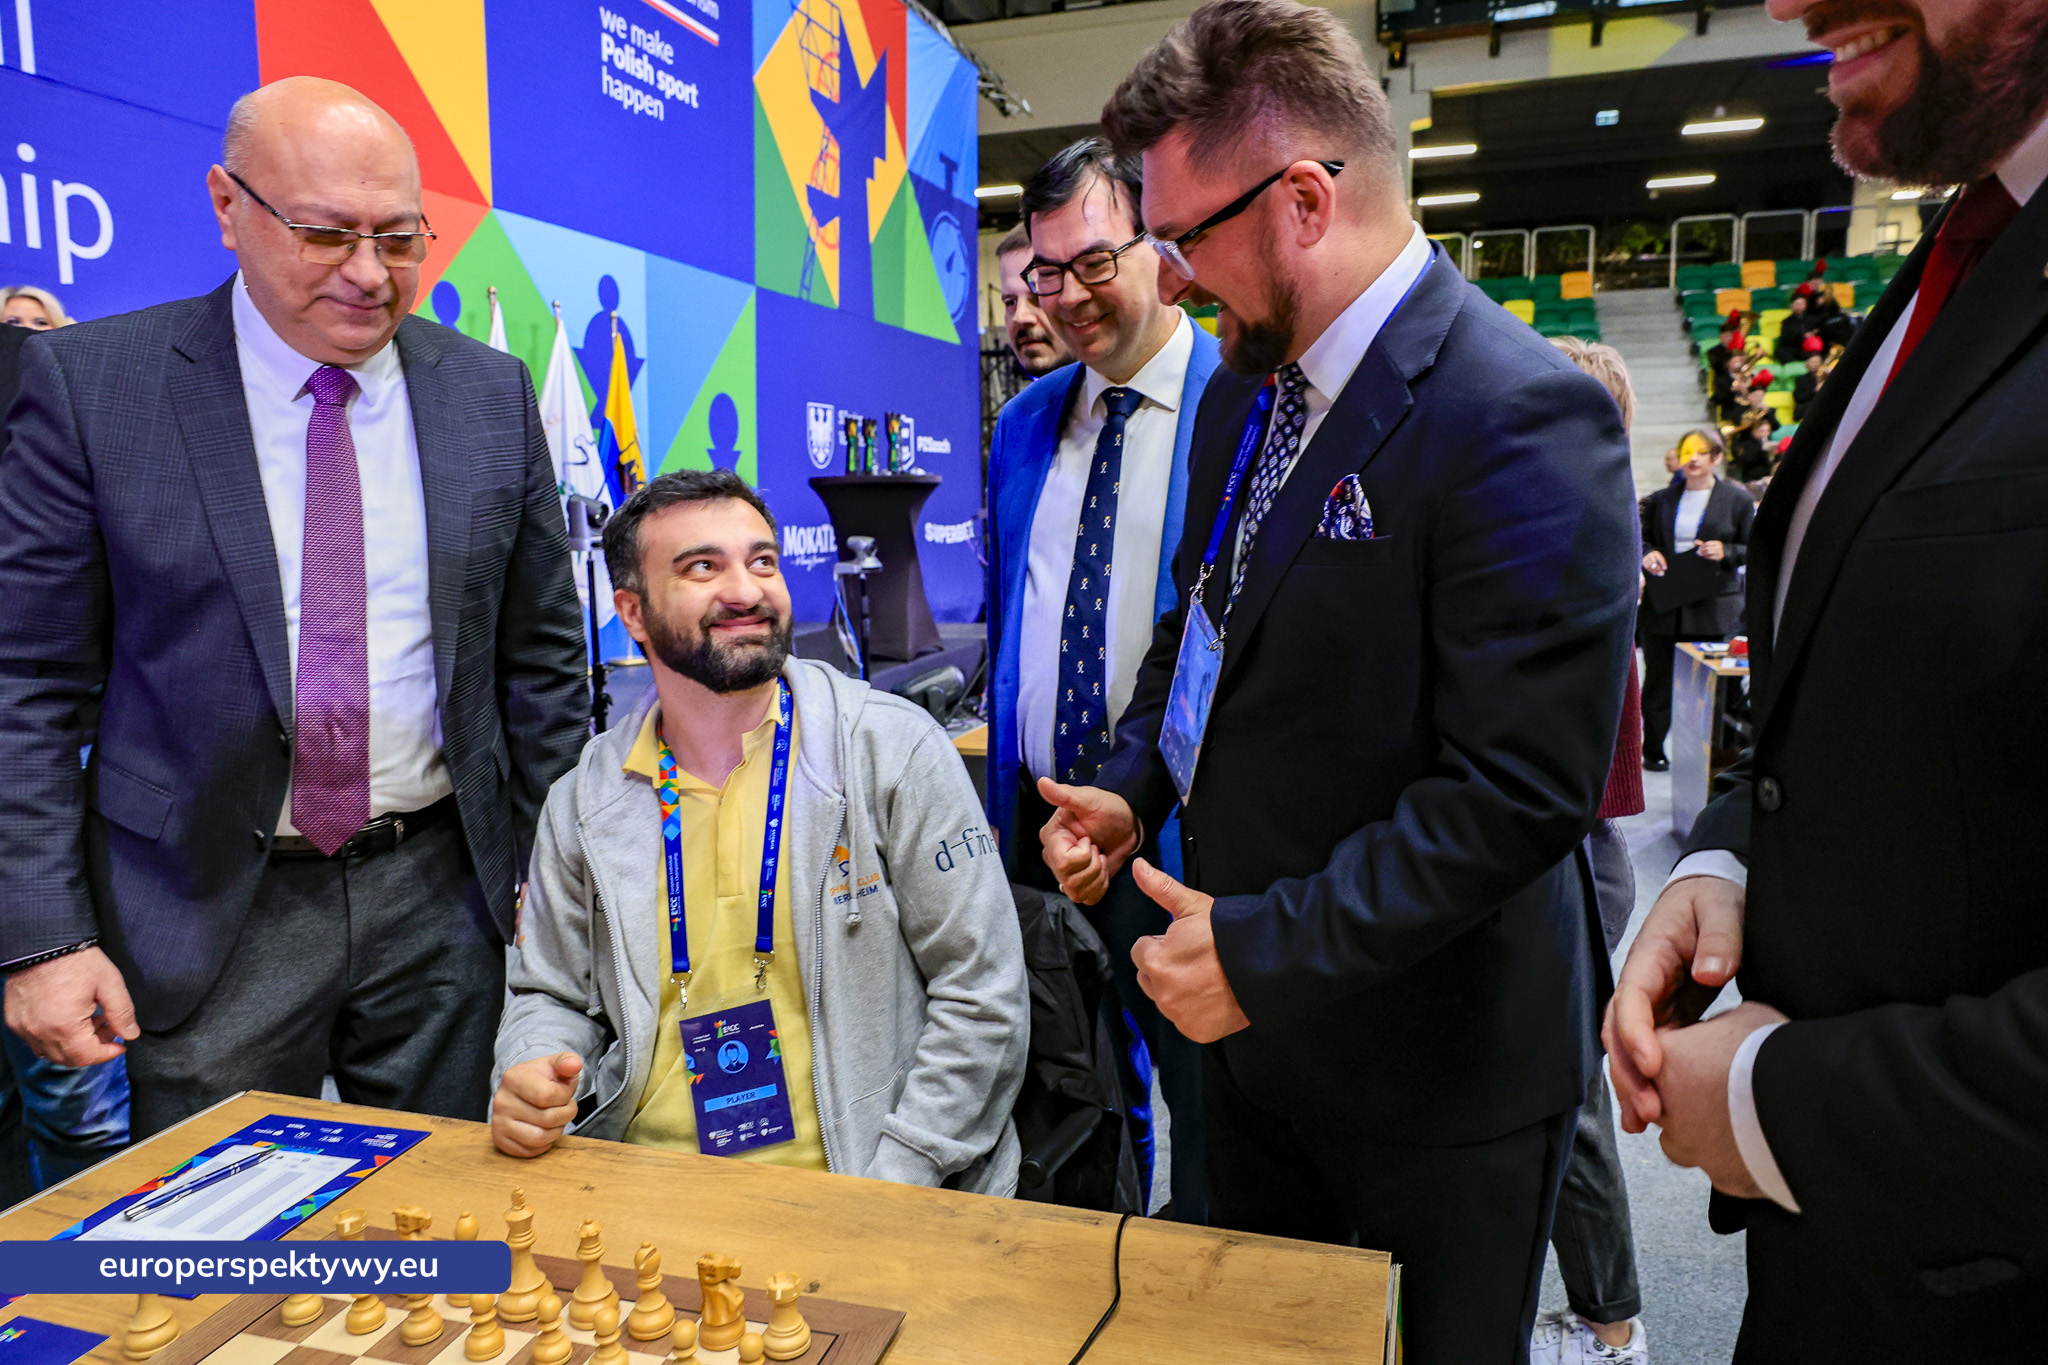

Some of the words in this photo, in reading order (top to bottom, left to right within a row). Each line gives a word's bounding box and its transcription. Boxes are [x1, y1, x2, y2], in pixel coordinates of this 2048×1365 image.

[599, 6, 628, 39] we
[630, 24, 674, 65] make
[601, 32, 655, 86] Polish
[656, 69, 699, 109] sport
[602, 65, 665, 121] happen
[726, 1091, 757, 1105] PLAYER
